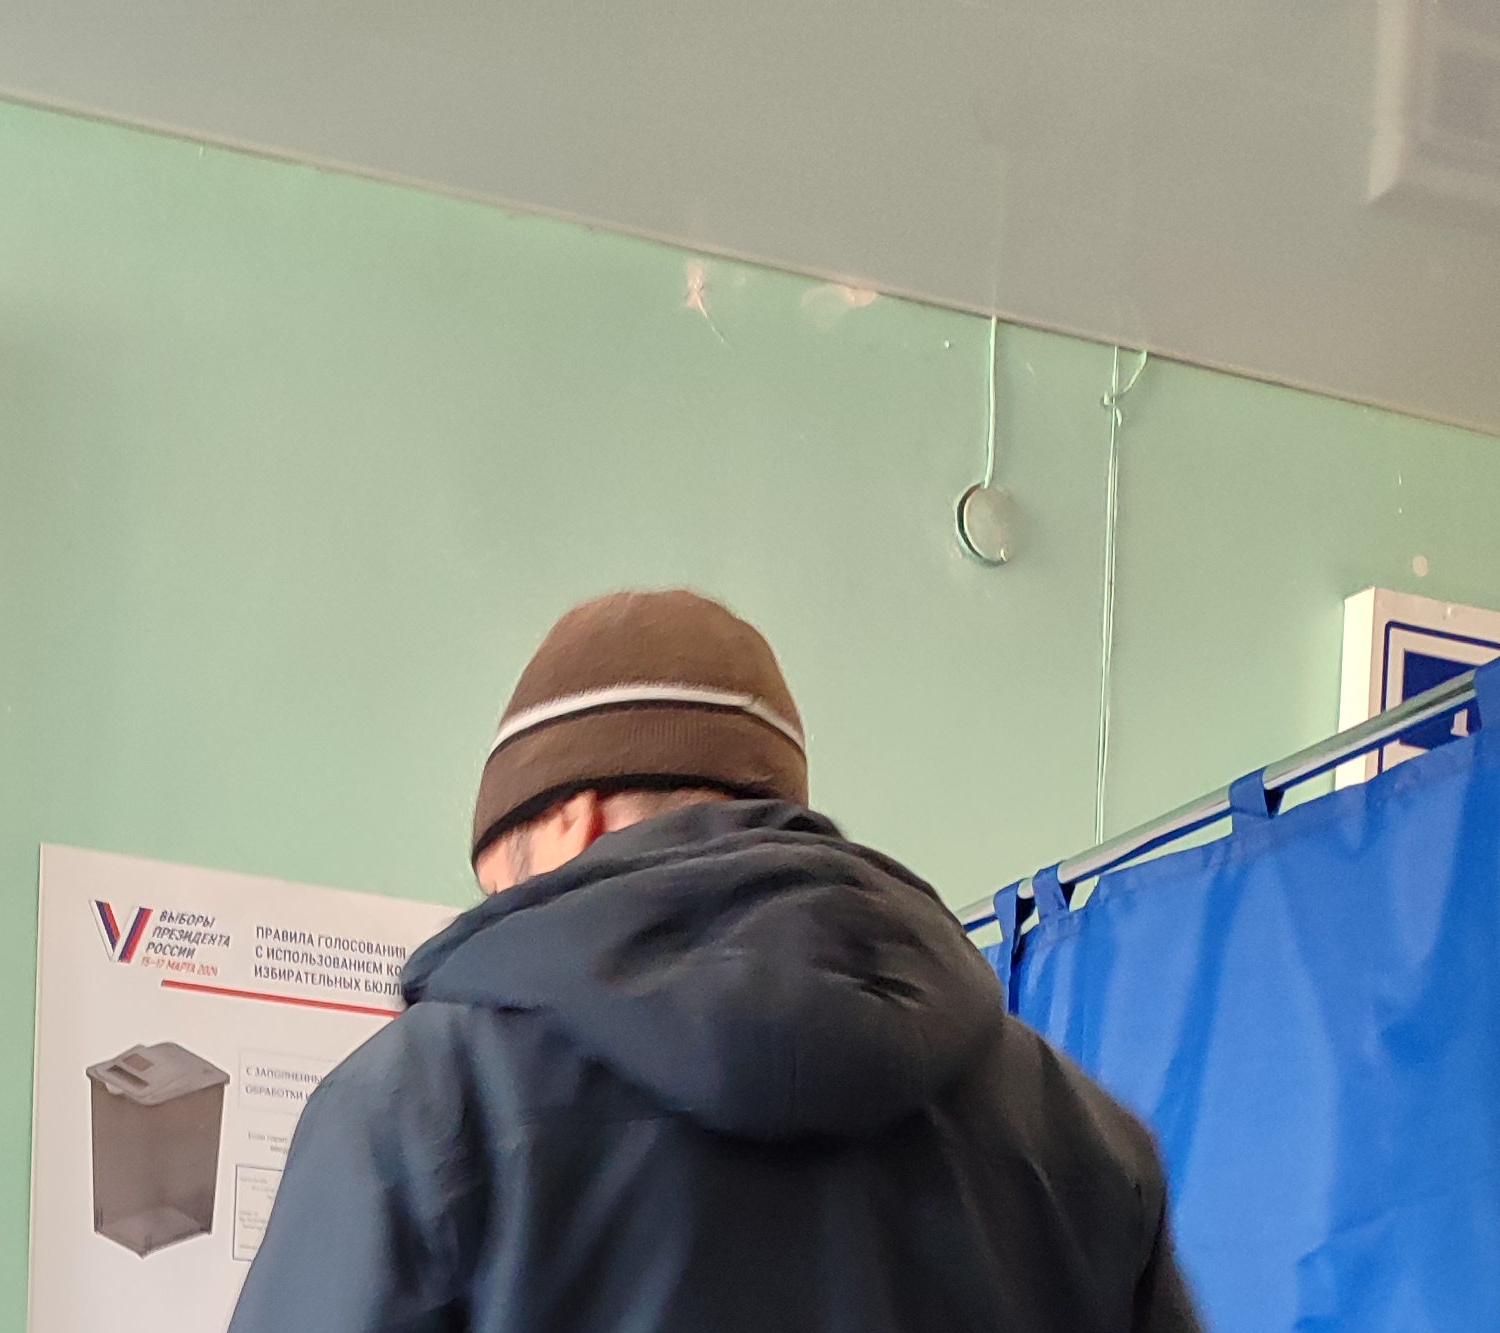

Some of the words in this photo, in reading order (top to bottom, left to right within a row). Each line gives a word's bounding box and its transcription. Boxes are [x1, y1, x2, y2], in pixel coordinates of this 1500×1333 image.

[159, 909, 215, 928] ВЫБОРЫ
[152, 926, 231, 948] ПРЕЗИДЕНТА
[256, 926, 314, 947] ПРАВИЛА
[318, 935, 406, 960] ГОЛОСОВАНИЯ
[146, 942, 196, 959] РОССИИ
[255, 945, 263, 958] С
[267, 946, 383, 975] ИСПОЛЬЗОВАНИЕМ
[254, 964, 361, 991] ИЗБИРАТЕЛЬНЫХ
